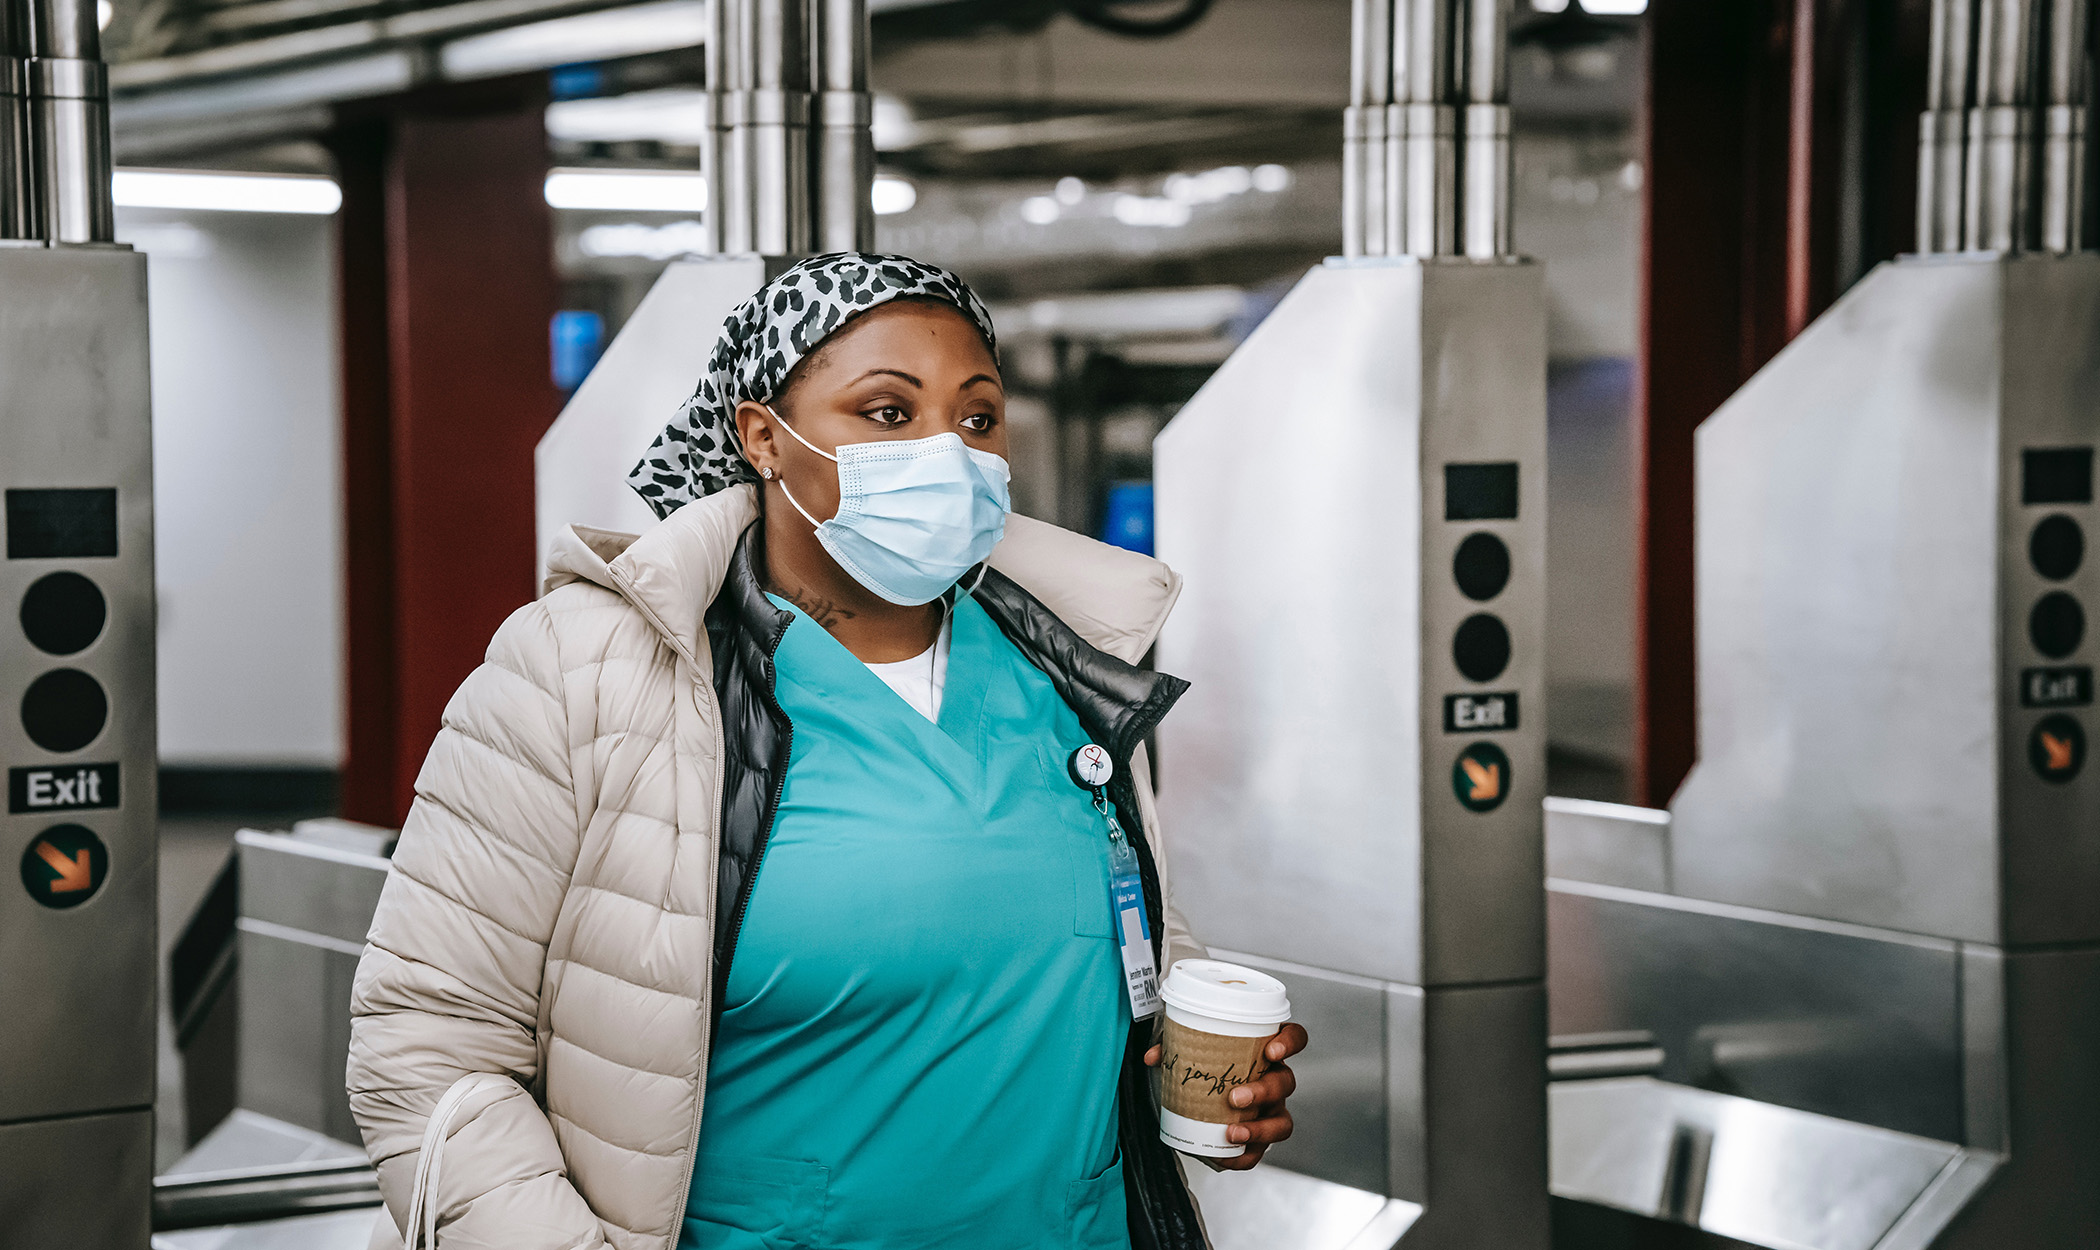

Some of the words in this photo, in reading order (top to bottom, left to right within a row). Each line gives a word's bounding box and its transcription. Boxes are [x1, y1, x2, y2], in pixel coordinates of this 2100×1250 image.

[1454, 697, 1505, 728] Exit
[27, 769, 102, 807] Exit
[1144, 978, 1157, 999] RN
[1181, 1060, 1257, 1097] joyful
